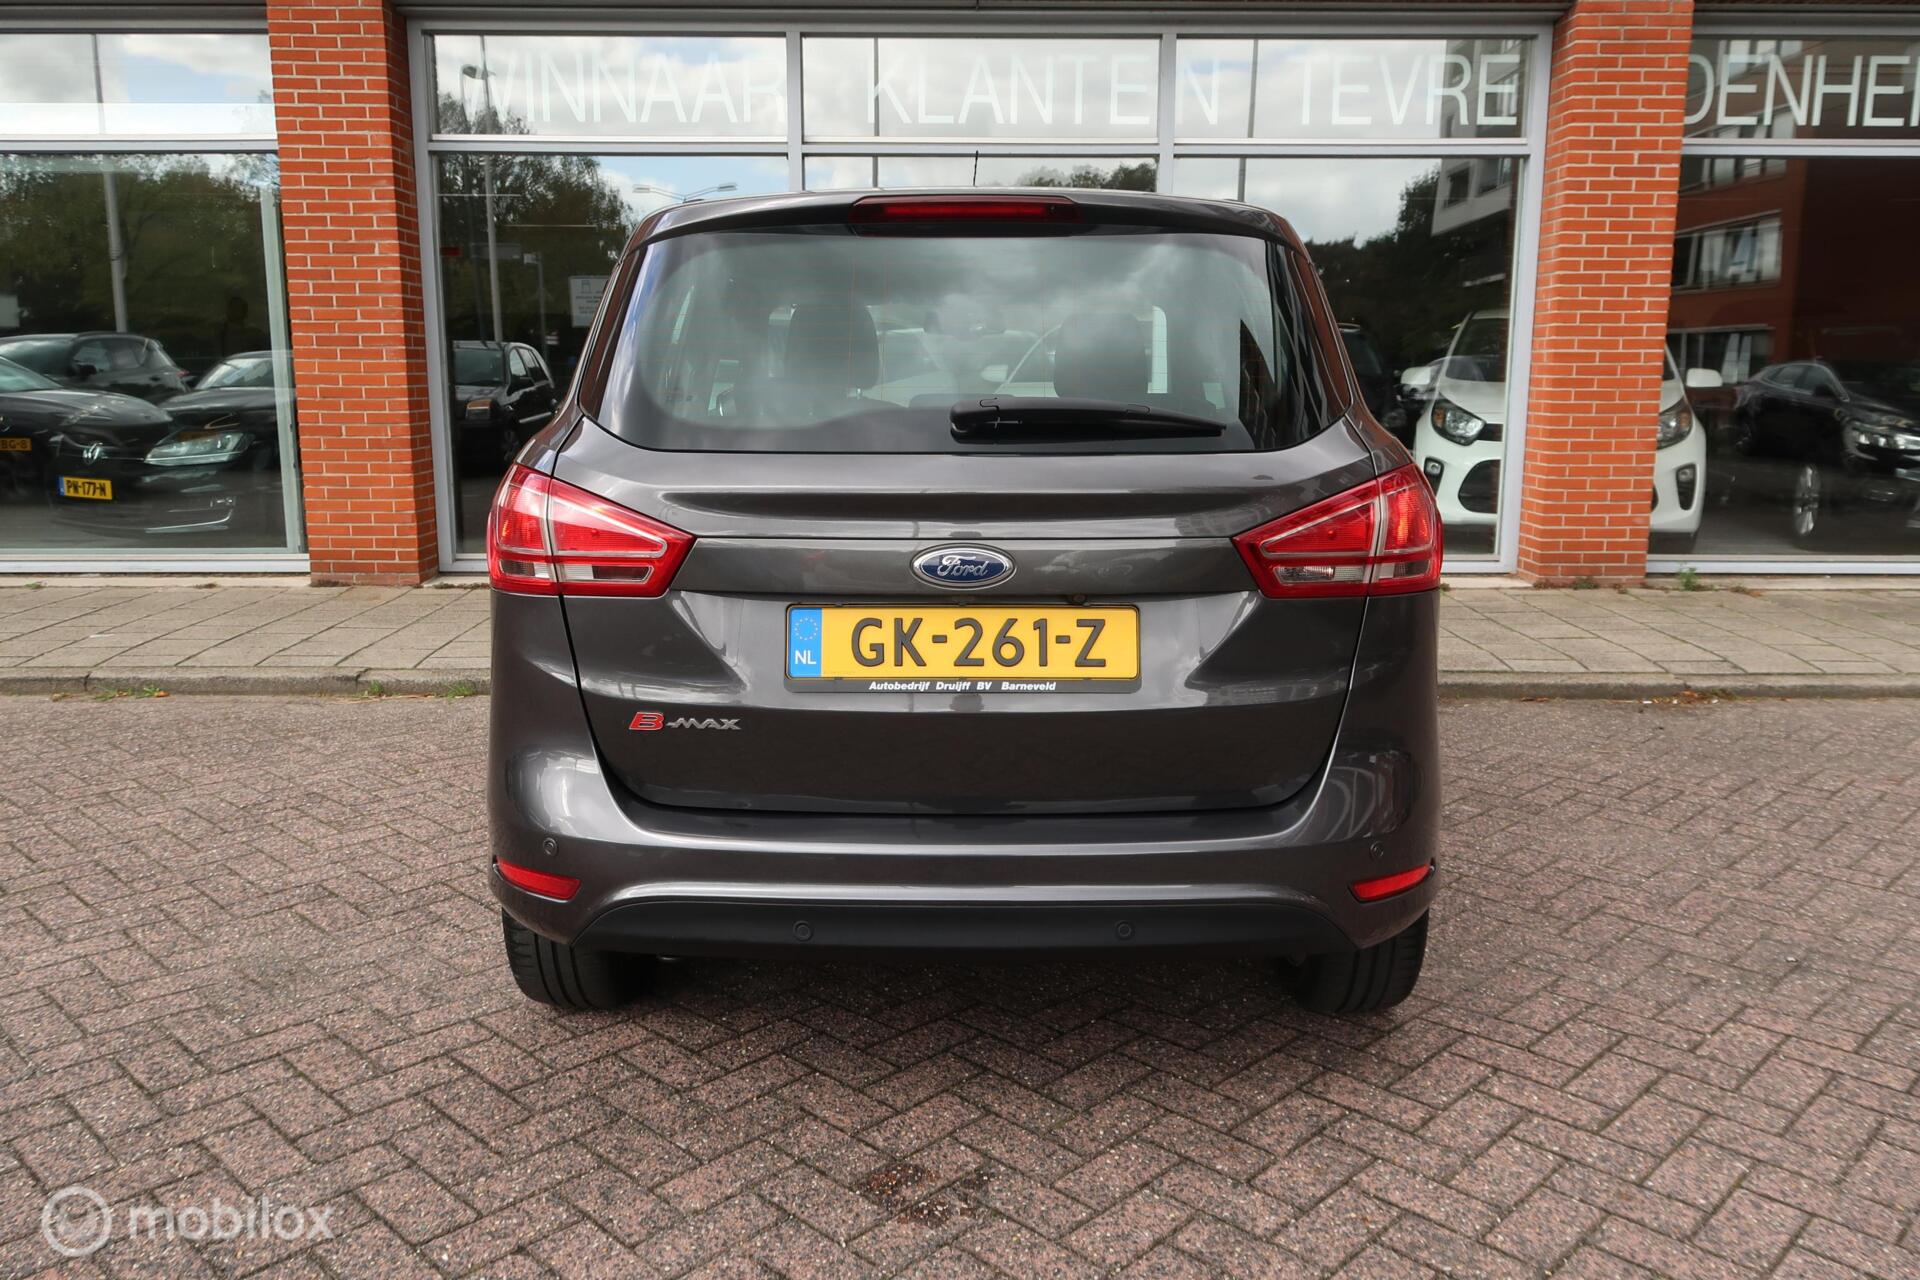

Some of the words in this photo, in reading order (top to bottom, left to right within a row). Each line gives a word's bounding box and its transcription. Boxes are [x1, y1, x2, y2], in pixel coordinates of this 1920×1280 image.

[459, 52, 788, 124] WINNAAR
[937, 555, 989, 577] Ford
[851, 617, 1107, 667] GK-261-Z
[794, 650, 817, 665] NL
[868, 681, 931, 692] Autobedrijf
[935, 681, 970, 692] Druijff
[976, 682, 993, 691] BV
[1001, 681, 1057, 692] Barneveld
